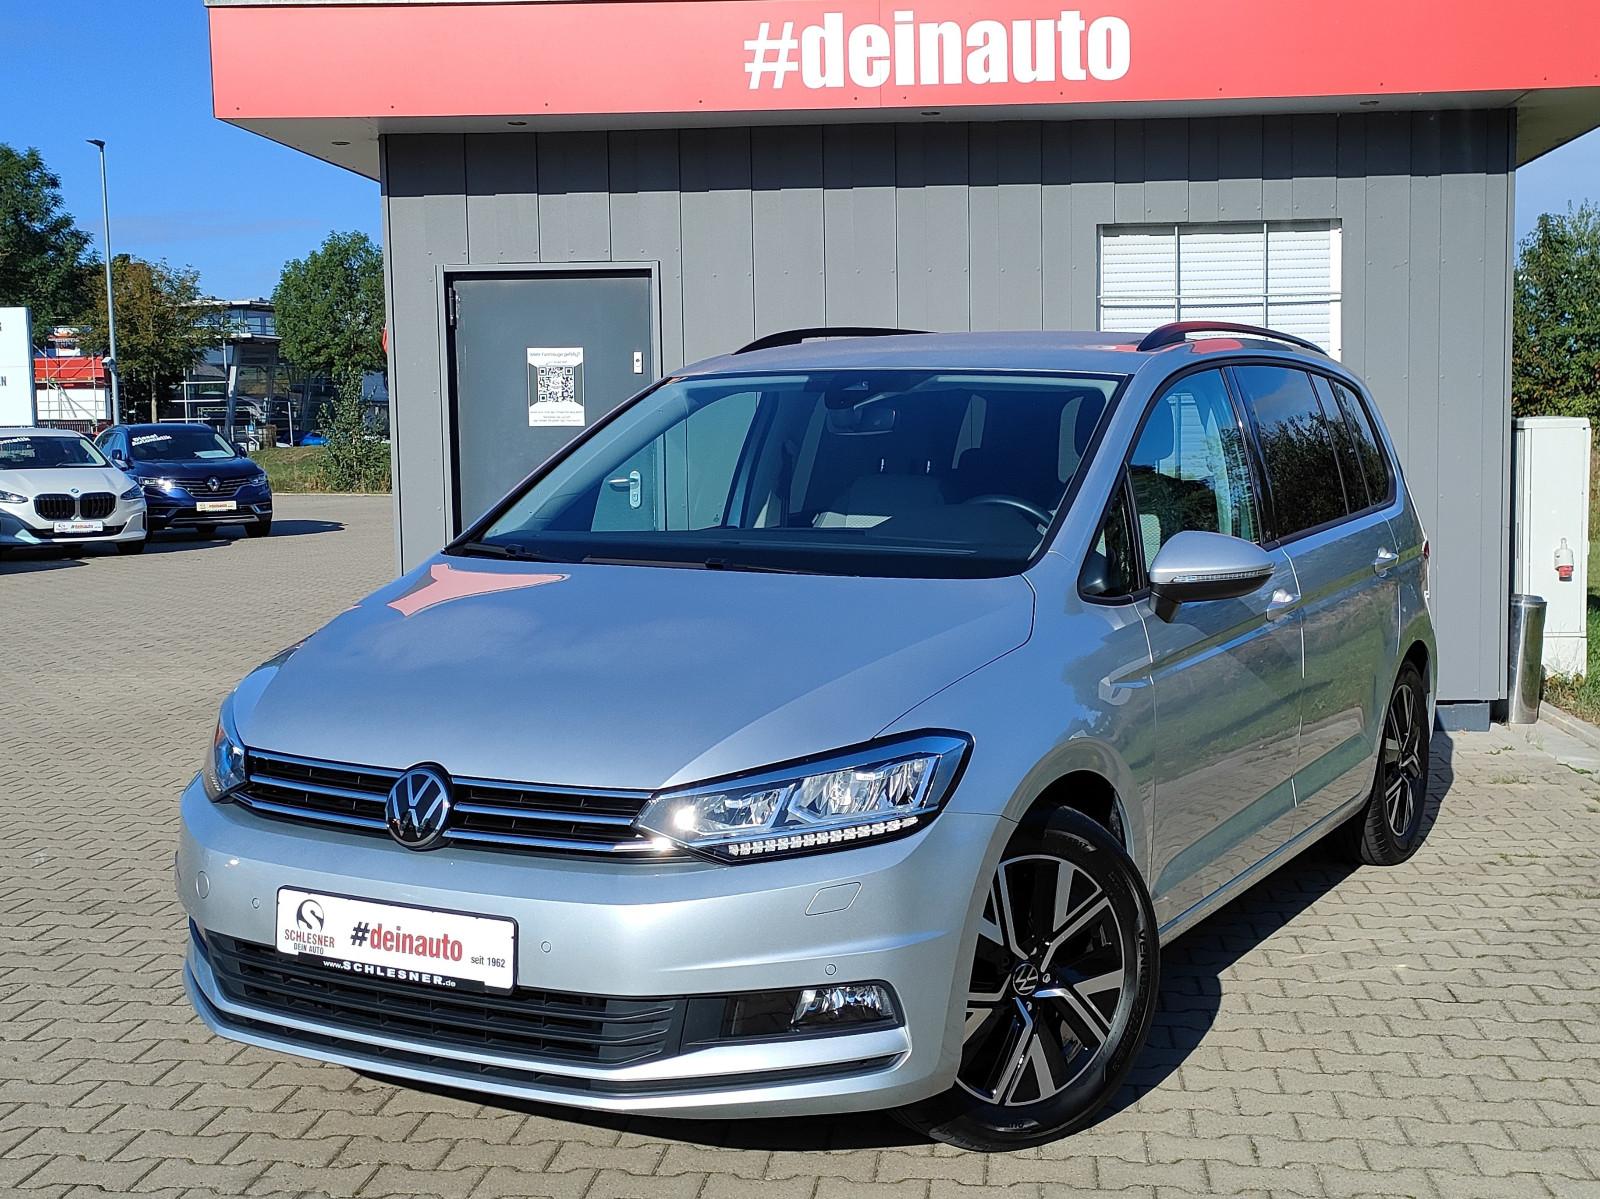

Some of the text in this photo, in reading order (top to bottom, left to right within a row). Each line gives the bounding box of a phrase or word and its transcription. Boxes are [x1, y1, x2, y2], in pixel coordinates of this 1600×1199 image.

[743, 10, 1131, 90] #deinauto
[285, 929, 335, 948] SCHLESNER
[294, 943, 324, 955] DEIN AUTO
[350, 922, 463, 962] #deinauto
[470, 955, 506, 968] seit 1962
[323, 960, 456, 988] www.SCHLESNER.de
